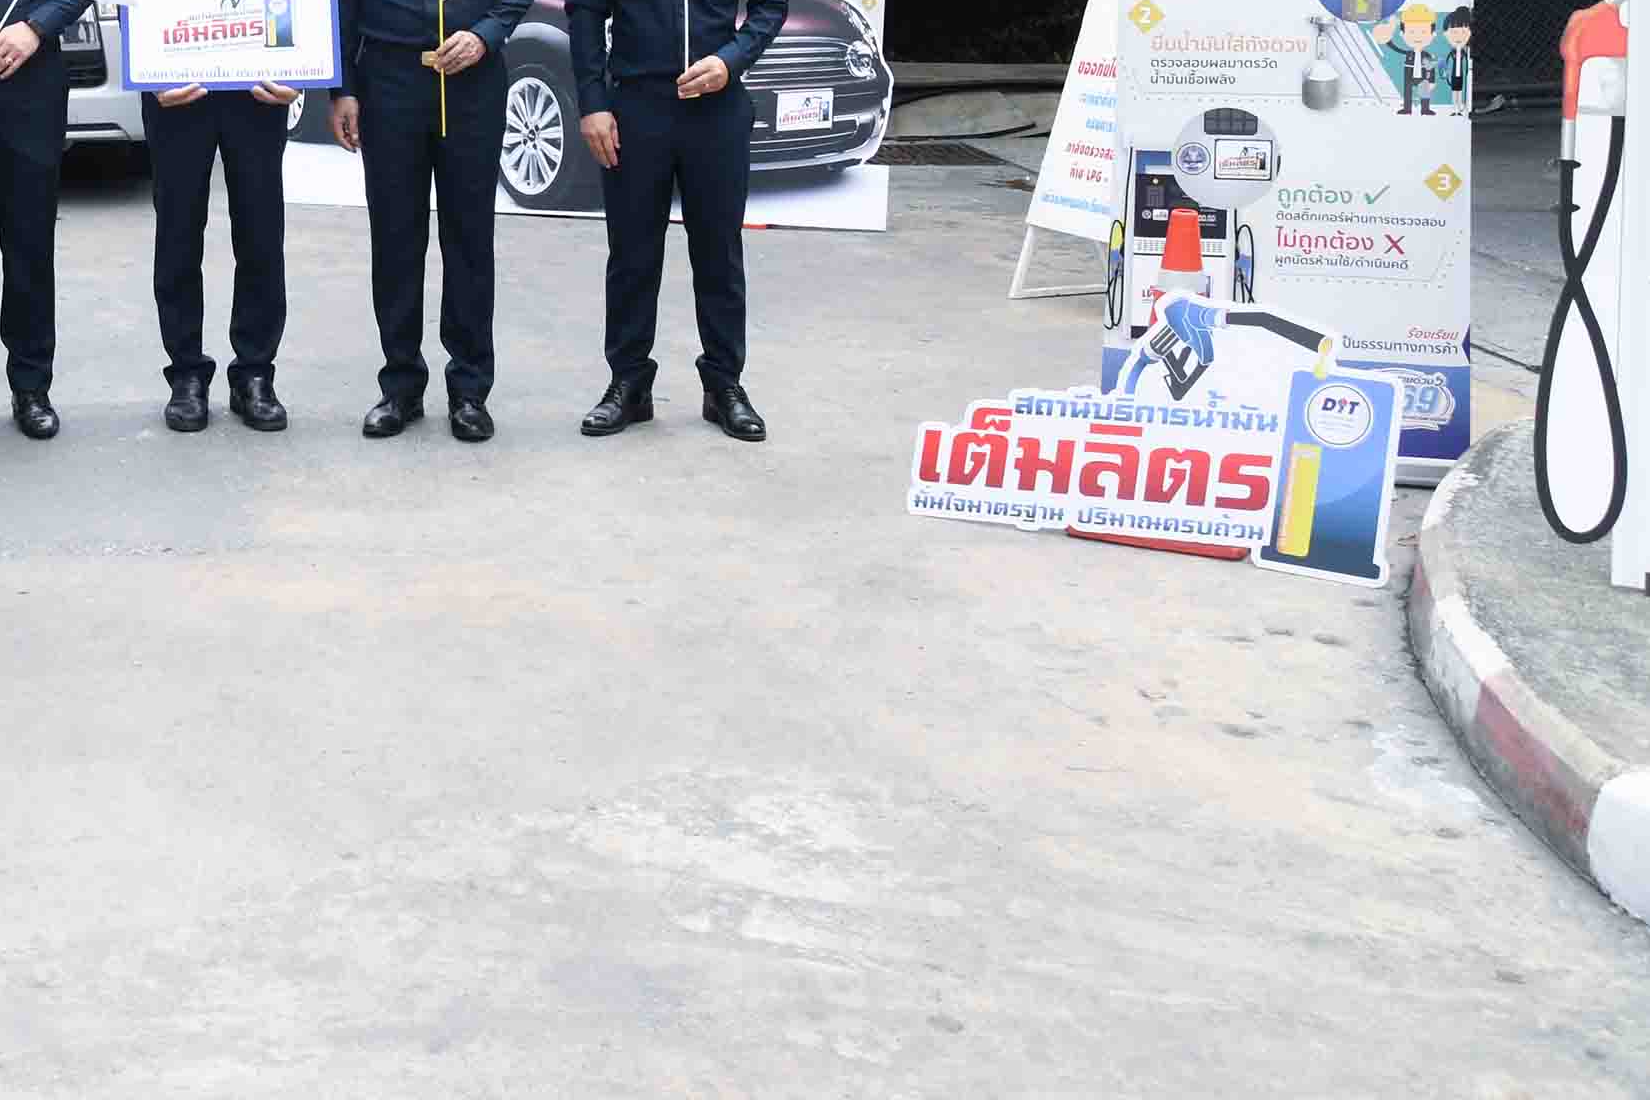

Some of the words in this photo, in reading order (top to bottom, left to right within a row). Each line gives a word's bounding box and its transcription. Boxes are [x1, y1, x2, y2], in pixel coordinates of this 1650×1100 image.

[1277, 185, 1353, 209] ถูกต้อง
[1276, 226, 1374, 255] ไม่ถูกต้อง
[1342, 334, 1459, 355] ป็นธรรมทางการค้า
[1014, 390, 1278, 433] สถานีบริการน้ำมัน
[1321, 396, 1360, 414] DIT
[918, 407, 1273, 512] เต็มลิตร
[1077, 506, 1265, 541] ปริมาณครบถ้วน
